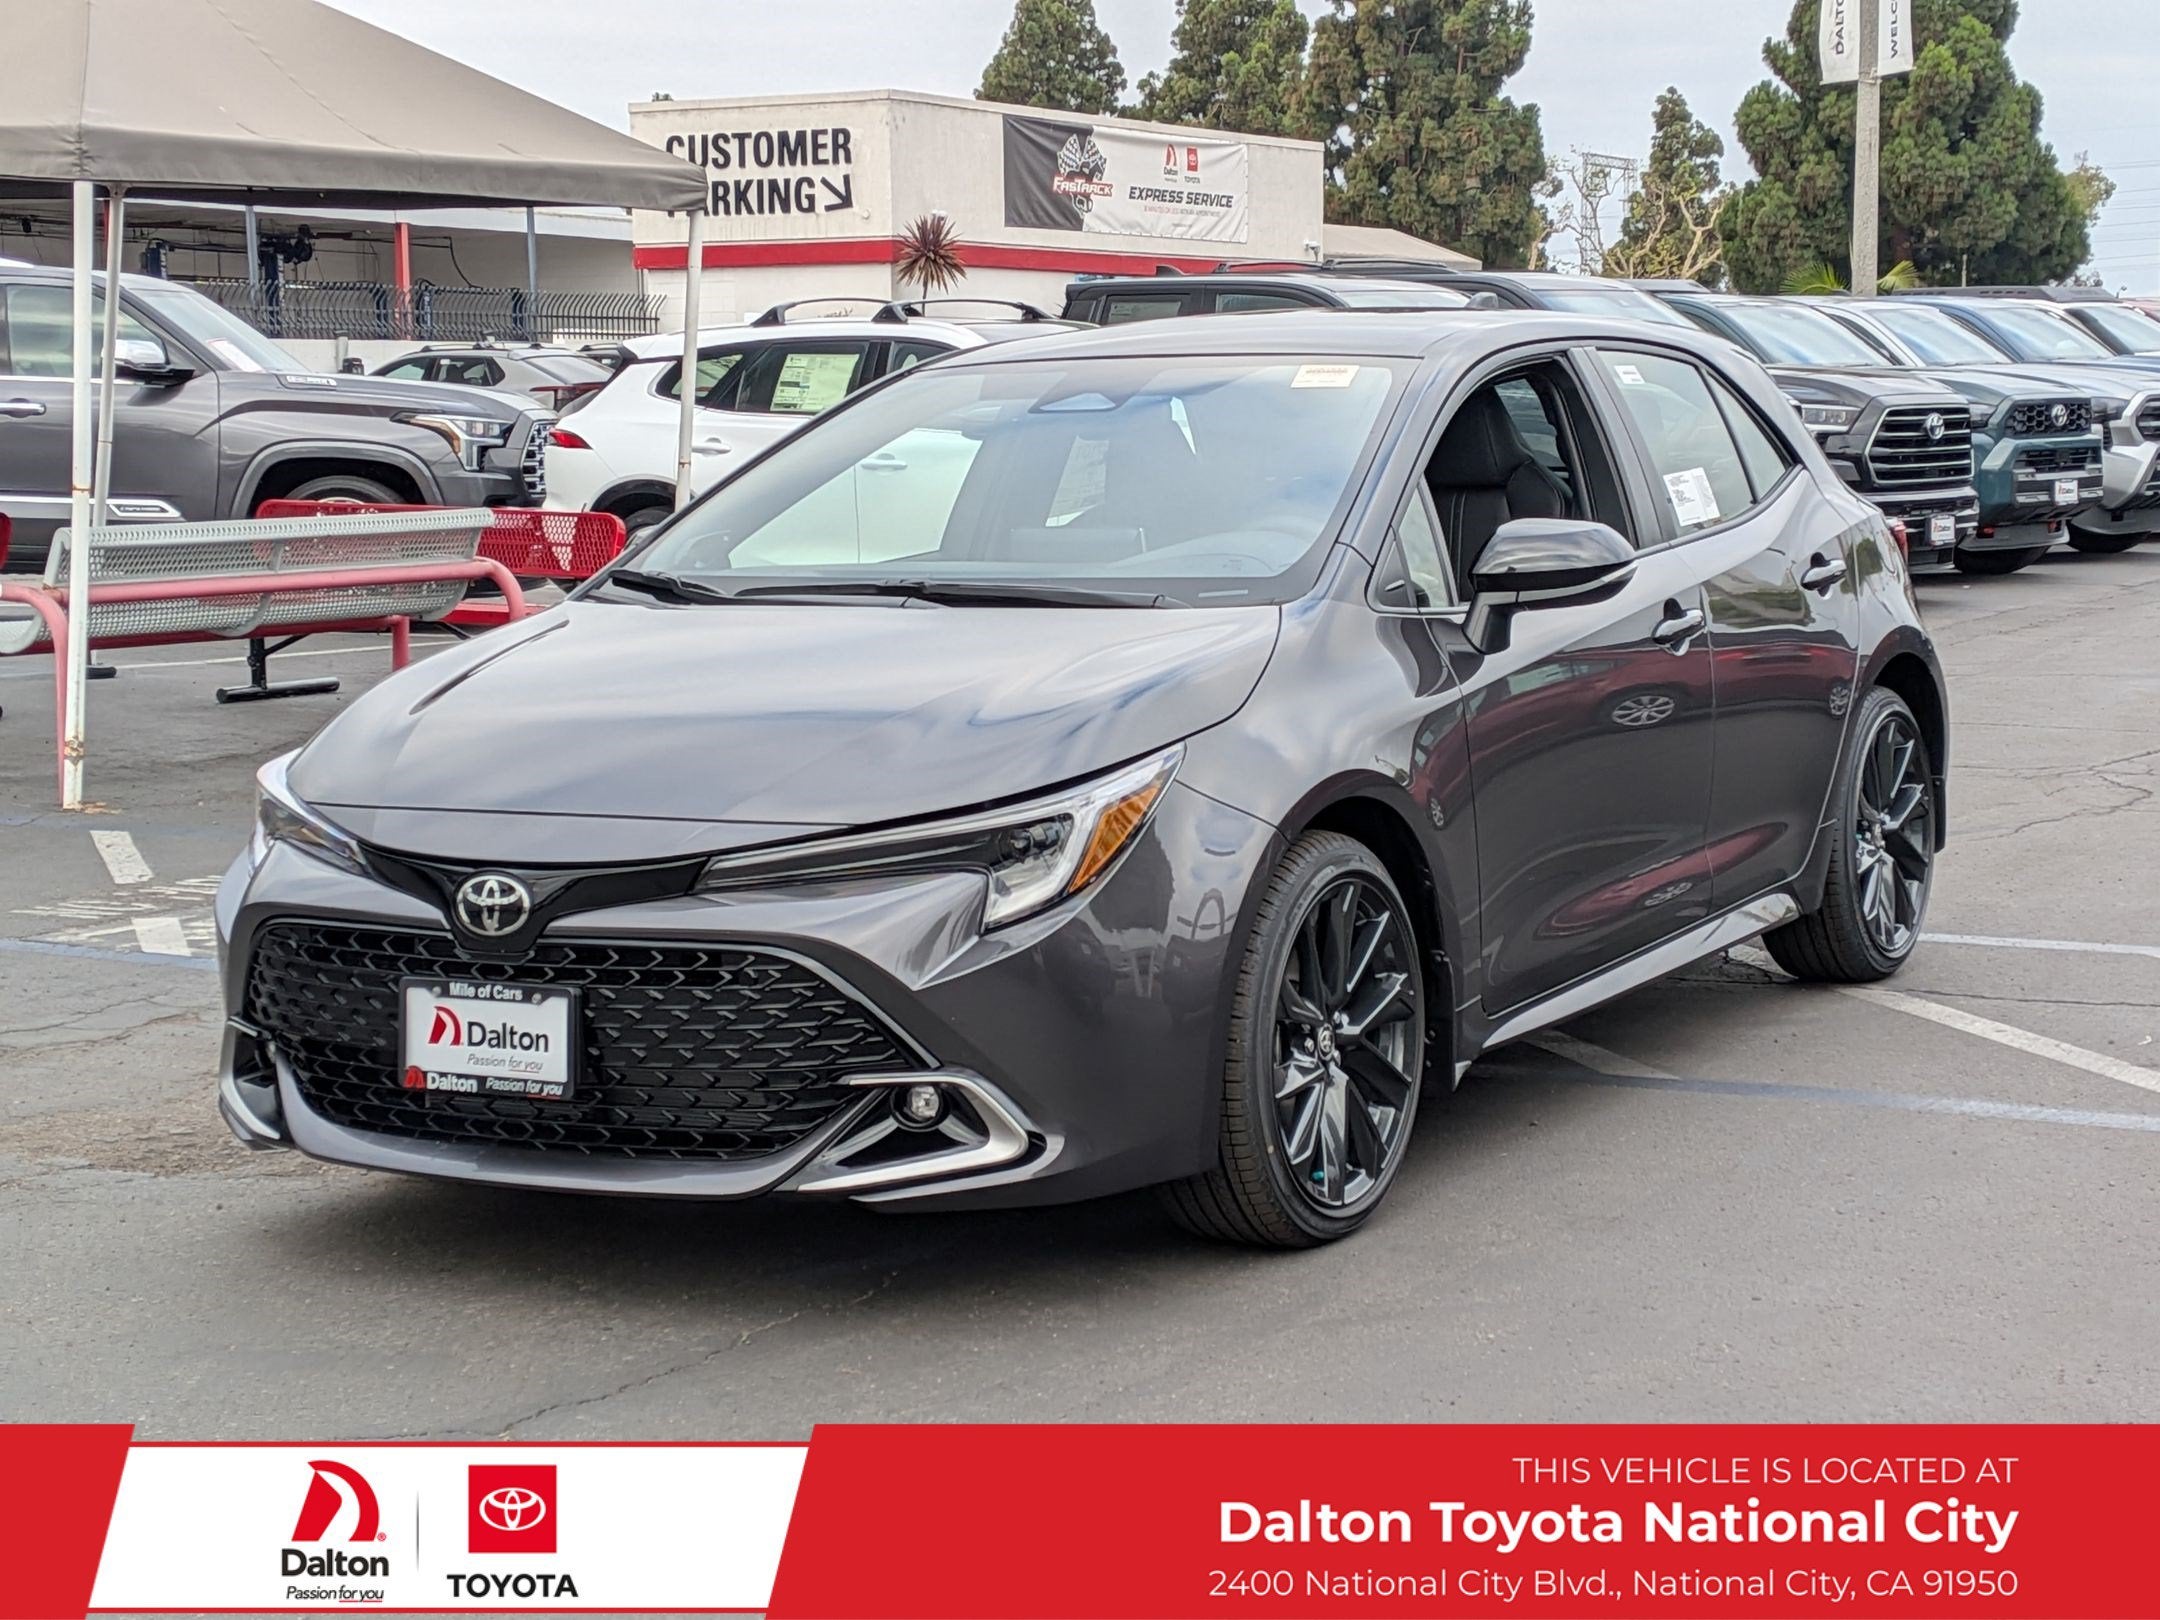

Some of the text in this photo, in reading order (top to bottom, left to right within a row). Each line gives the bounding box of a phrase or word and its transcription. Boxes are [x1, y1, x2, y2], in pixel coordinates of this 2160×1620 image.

[1890, 0, 1898, 59] WELC
[1128, 185, 1234, 209] EXPRESS SERVICE
[449, 982, 523, 1001] Mile of Cars
[467, 1021, 549, 1053] Dalton
[467, 1053, 543, 1071] Passion for you
[426, 1072, 479, 1093] Dalton
[485, 1077, 563, 1097] Passion for you
